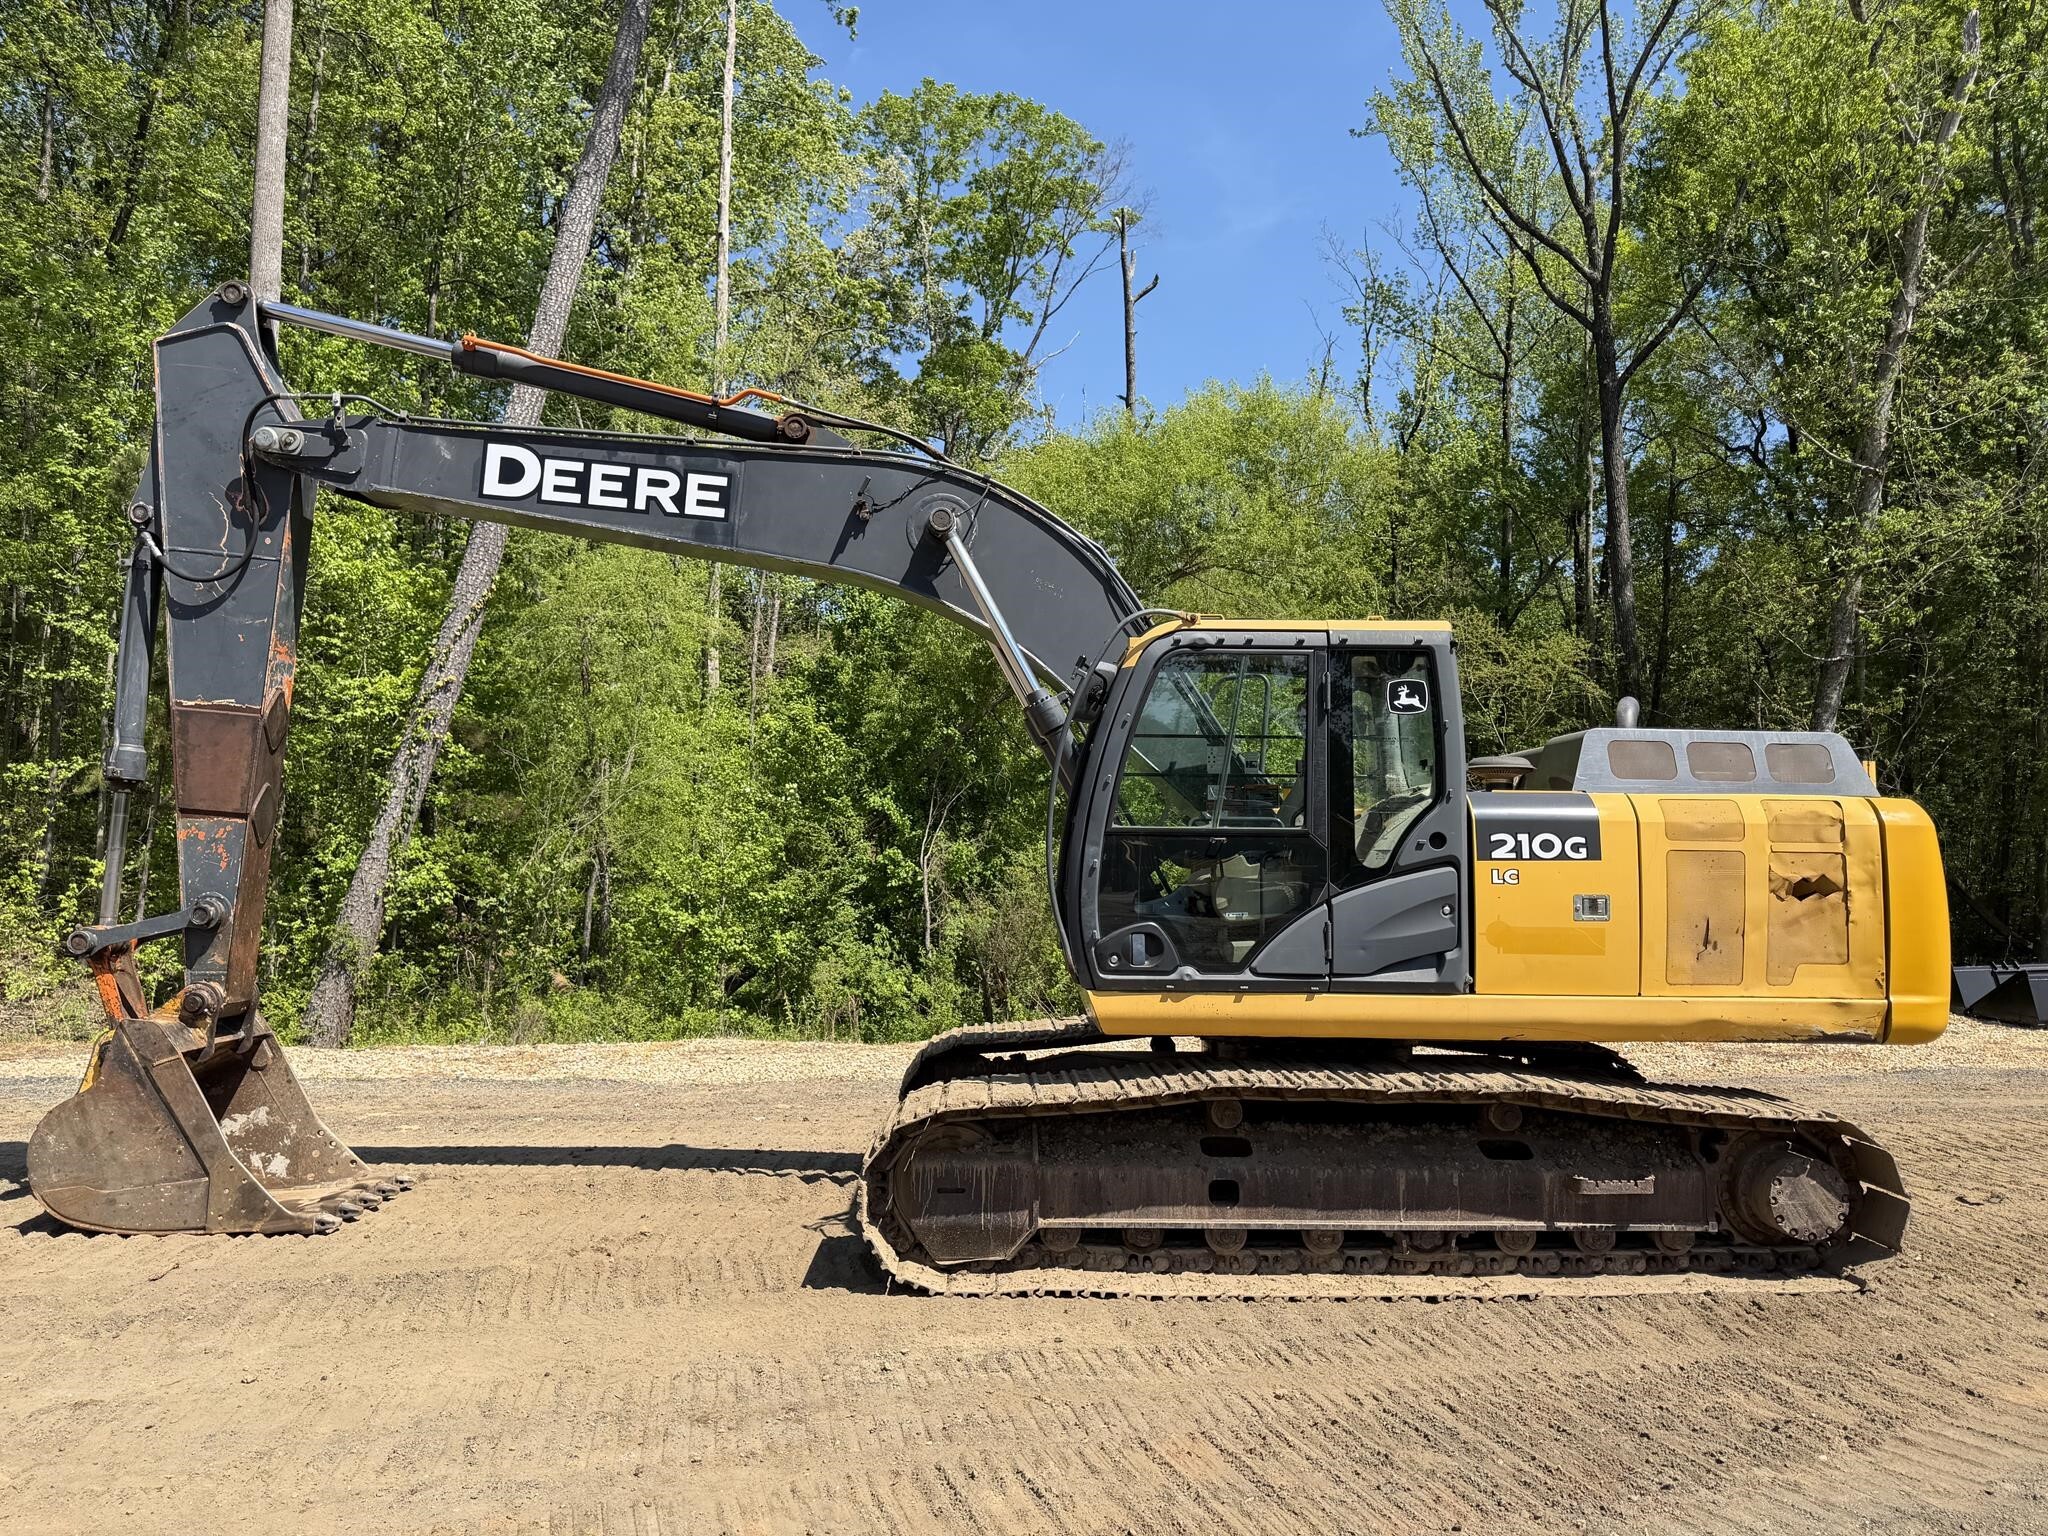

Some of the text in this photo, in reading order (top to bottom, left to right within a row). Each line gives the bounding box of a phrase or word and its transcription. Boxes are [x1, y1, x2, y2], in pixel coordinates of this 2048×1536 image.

[482, 443, 728, 518] DEERE
[1490, 832, 1587, 859] 210G
[1492, 869, 1519, 884] LC
